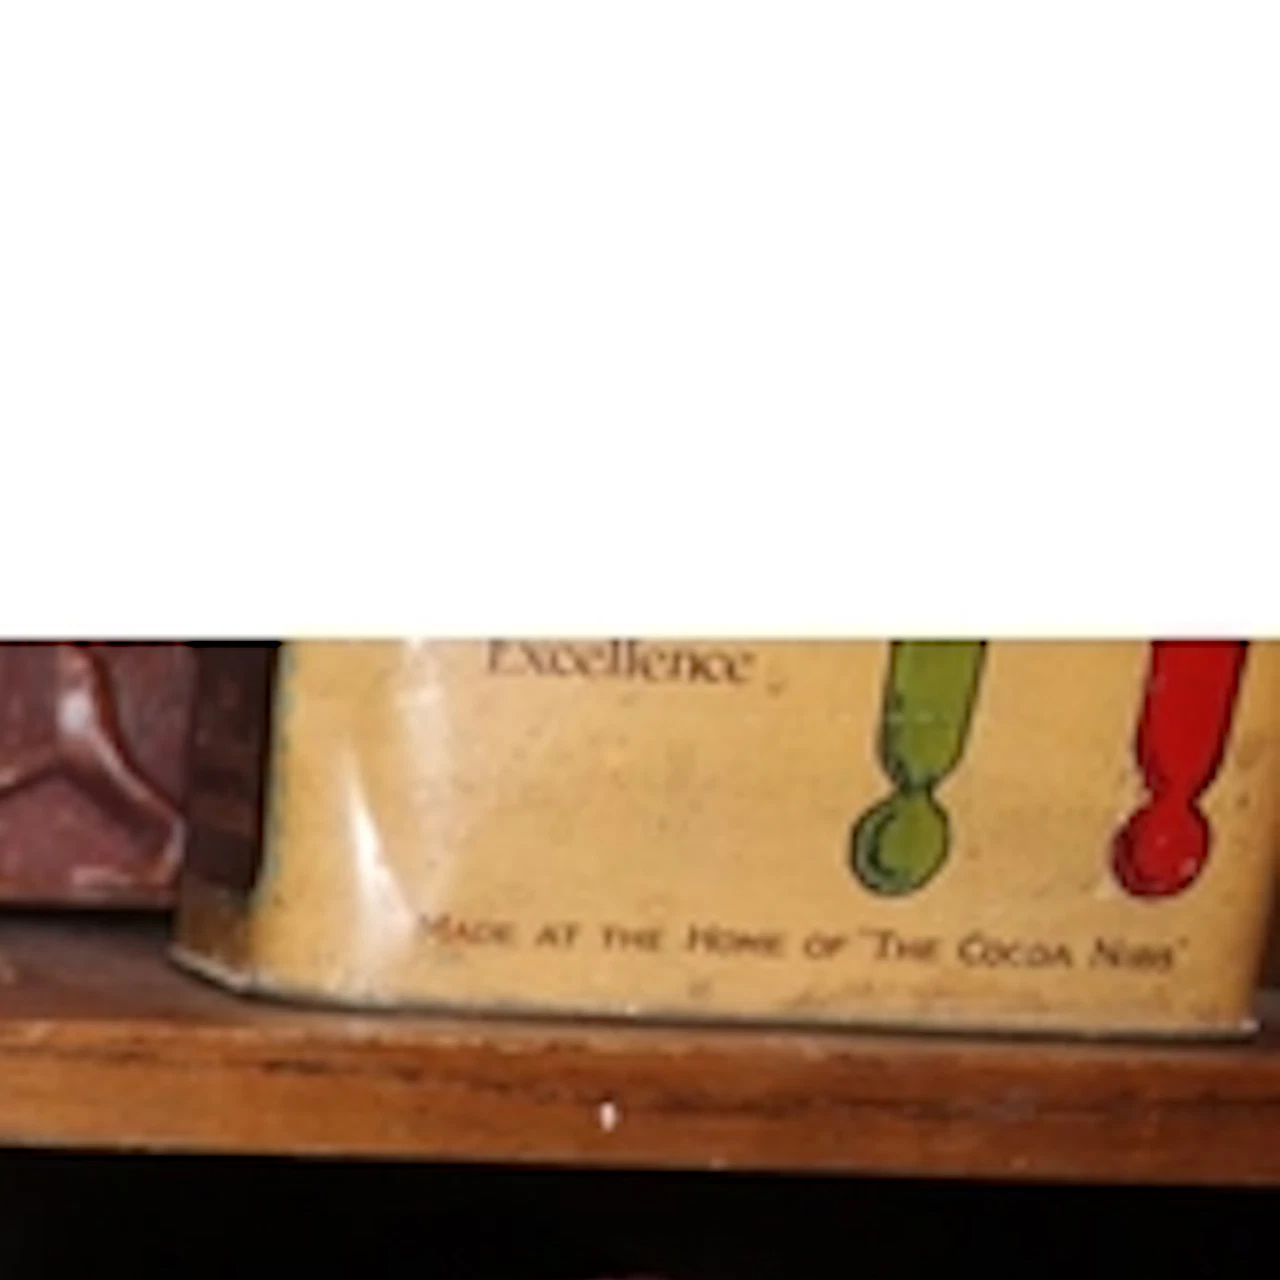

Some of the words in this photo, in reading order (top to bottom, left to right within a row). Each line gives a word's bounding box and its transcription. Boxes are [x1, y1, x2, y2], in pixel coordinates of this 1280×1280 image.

[533, 919, 582, 949] AT
[596, 920, 664, 953] THE
[684, 920, 786, 959] HOME
[801, 927, 851, 961] OF
